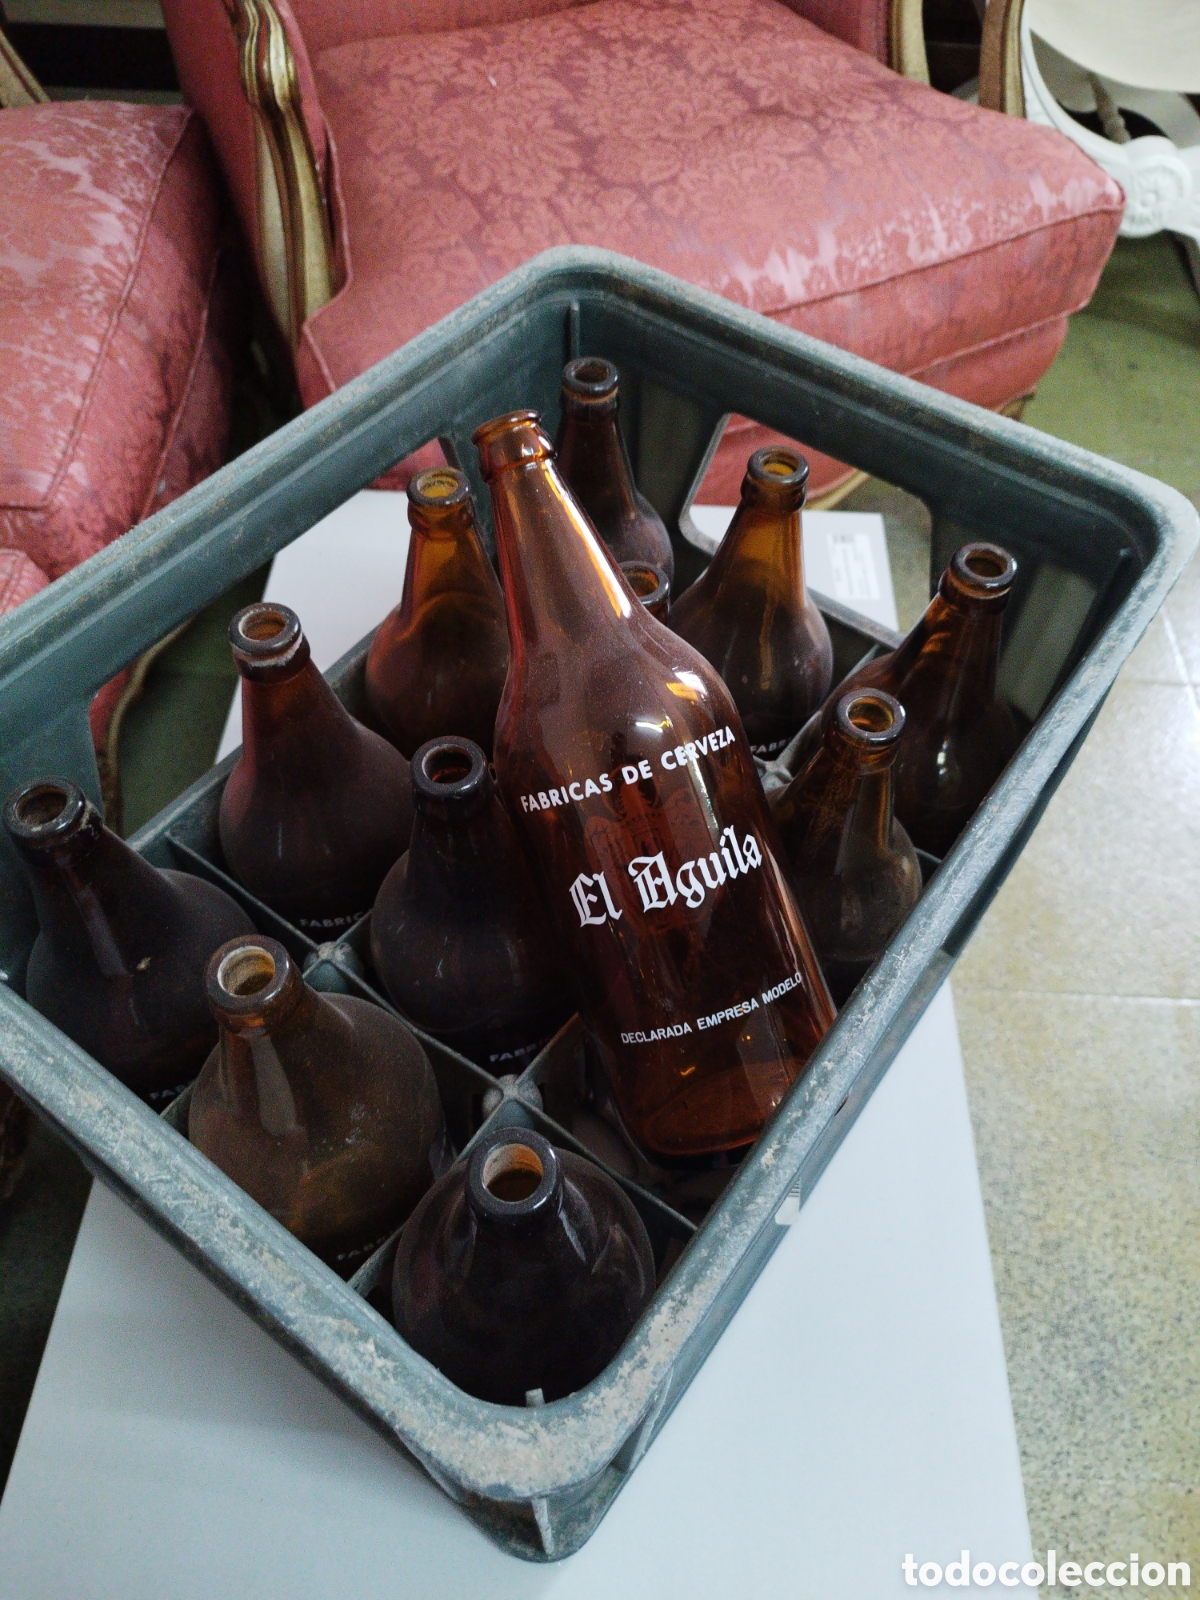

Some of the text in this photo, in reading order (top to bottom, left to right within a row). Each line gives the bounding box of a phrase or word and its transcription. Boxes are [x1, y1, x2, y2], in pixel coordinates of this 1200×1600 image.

[520, 726, 736, 813] FABRICAS DE CERVEZA
[568, 872, 623, 928] El
[621, 971, 802, 1044] DECLARADA EMPRESA MODELO
